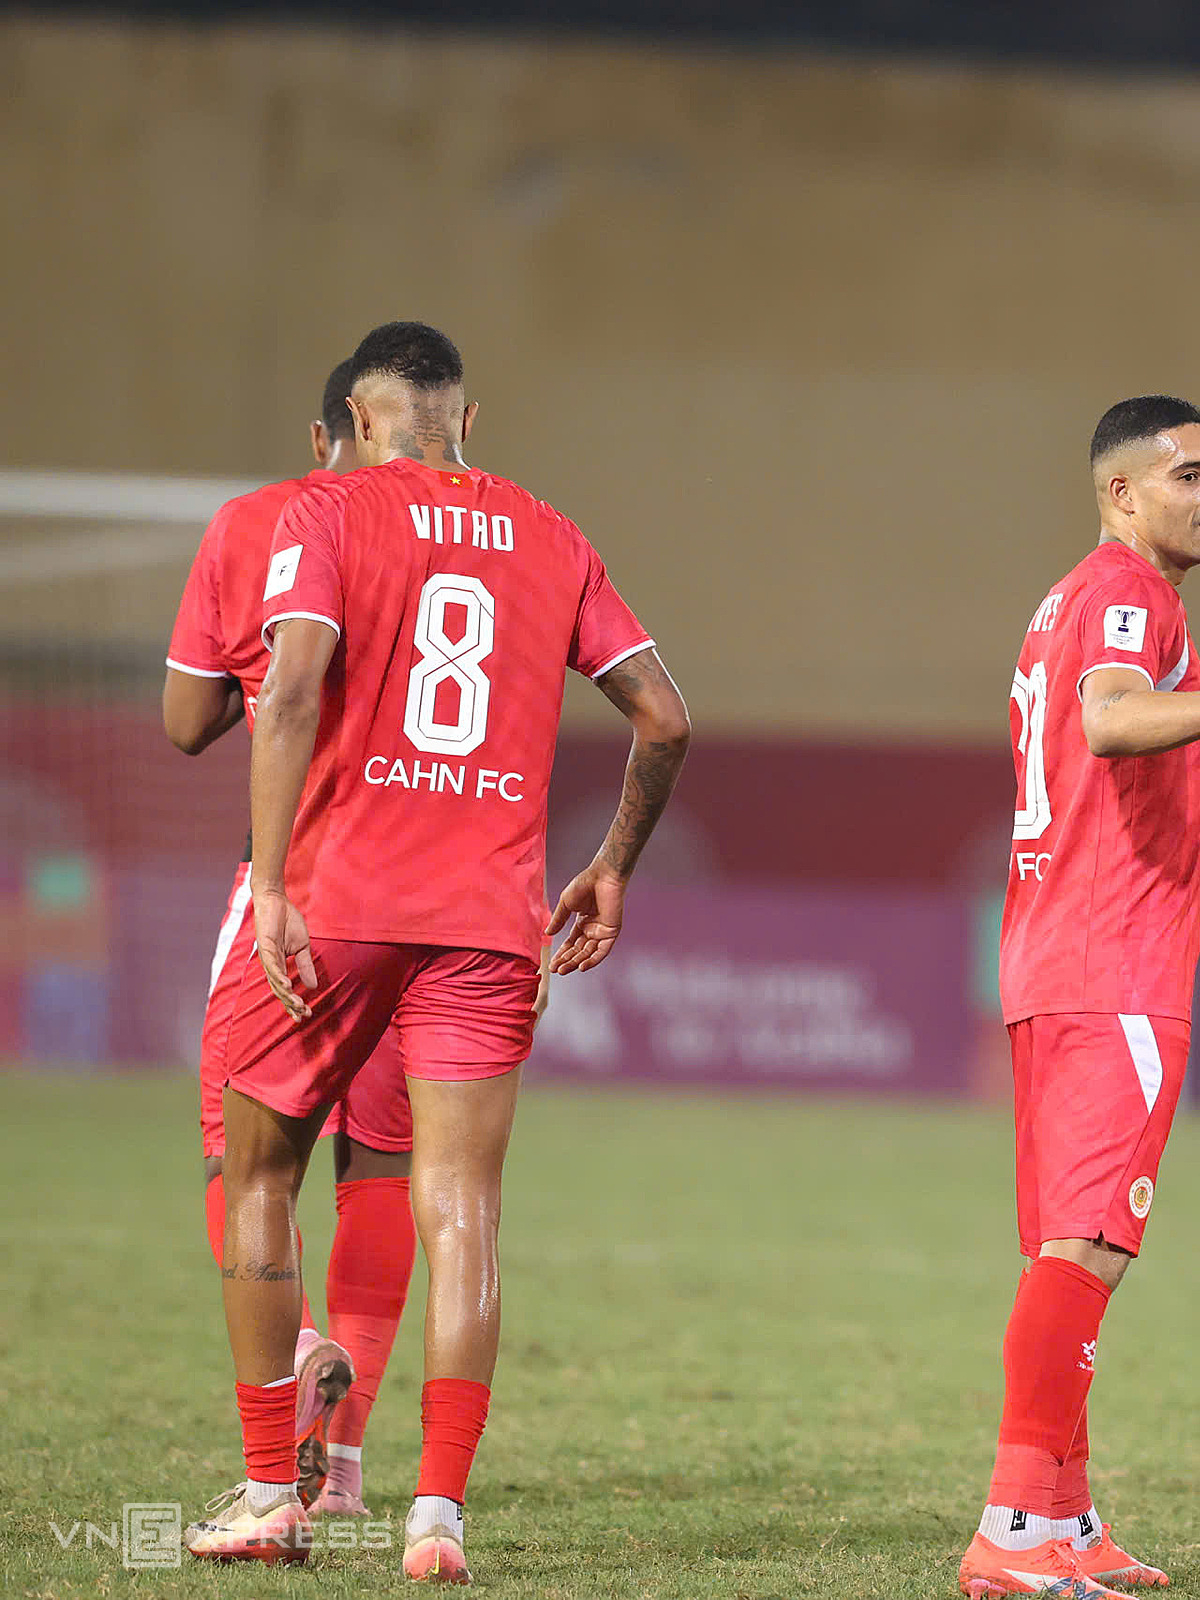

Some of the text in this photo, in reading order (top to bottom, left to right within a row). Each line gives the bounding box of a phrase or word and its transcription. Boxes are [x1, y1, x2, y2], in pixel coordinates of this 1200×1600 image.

[404, 573, 494, 757] 8
[364, 755, 525, 802] CAHN FC
